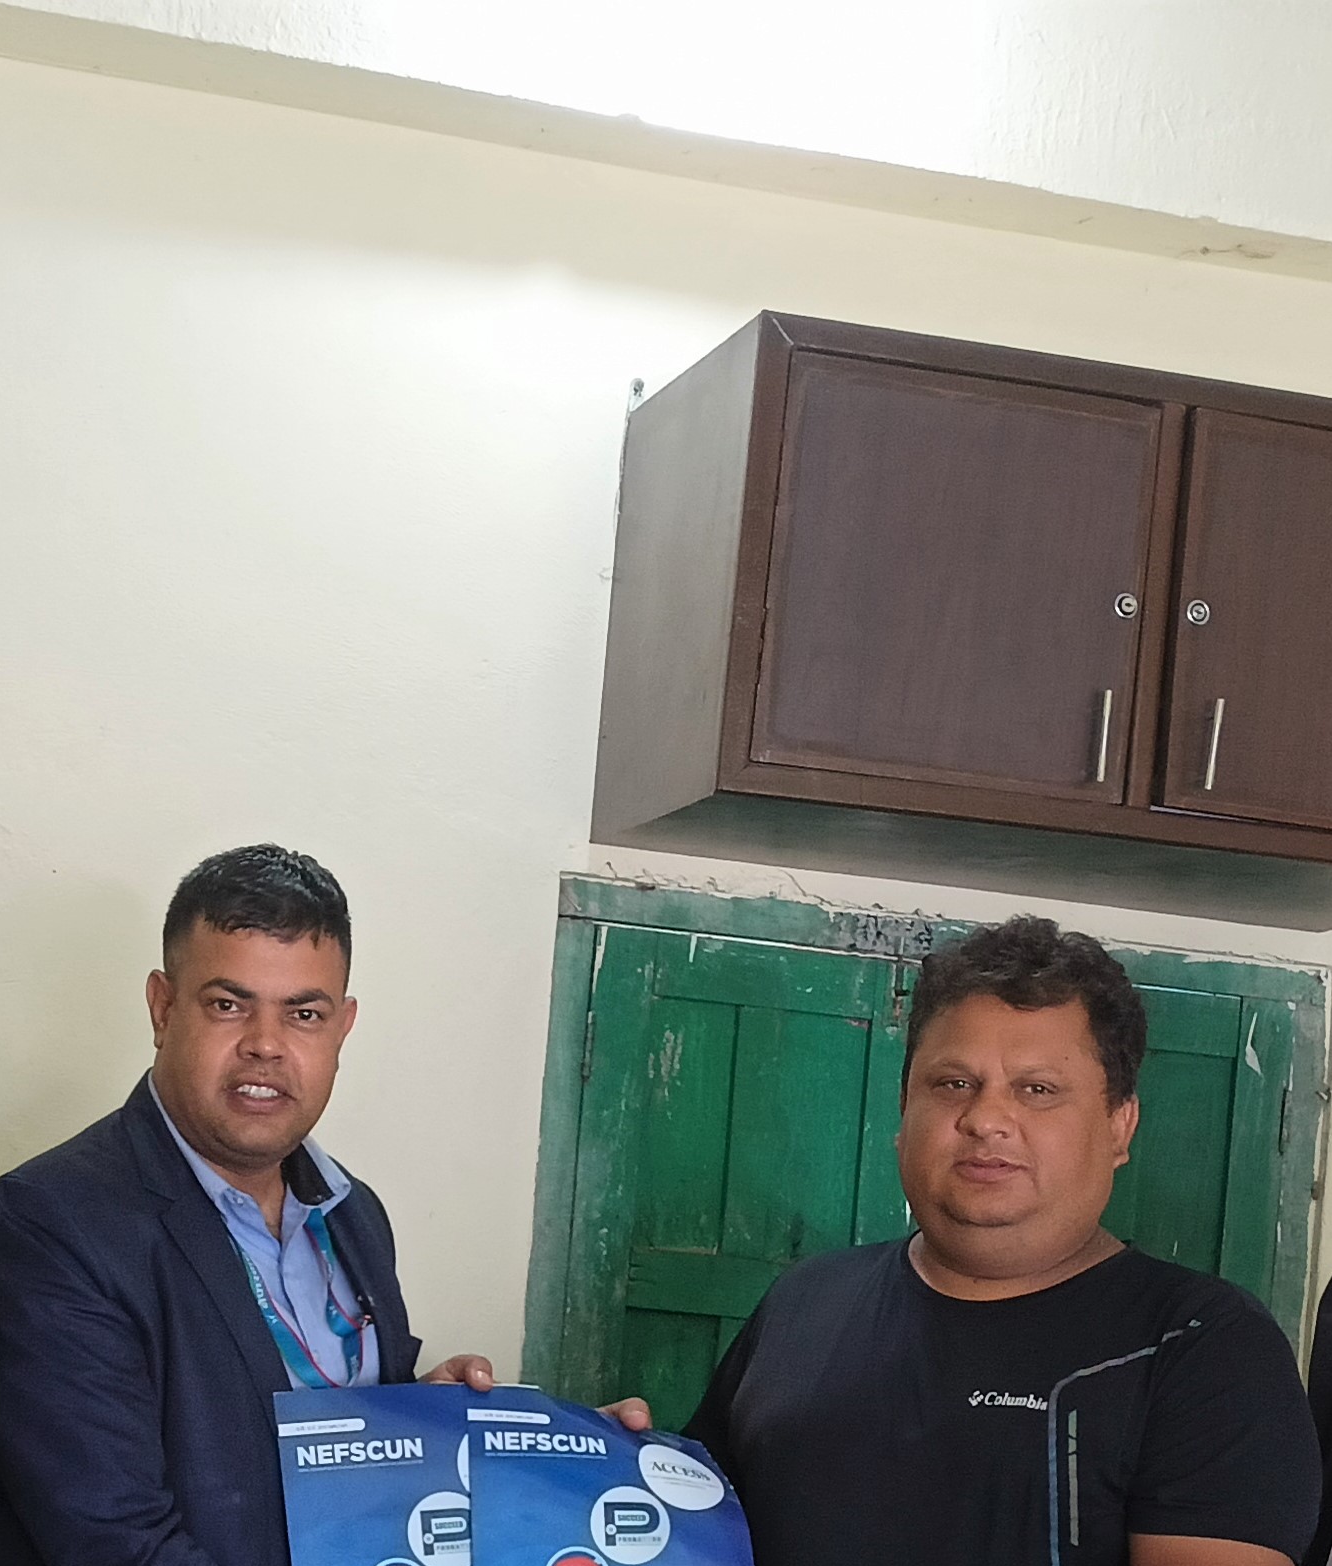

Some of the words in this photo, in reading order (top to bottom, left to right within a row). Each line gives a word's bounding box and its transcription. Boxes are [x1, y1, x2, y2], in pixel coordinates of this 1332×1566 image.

[984, 1391, 1048, 1411] Columbia
[296, 1438, 424, 1467] NEFSCUN
[484, 1431, 607, 1455] NEFSCUN
